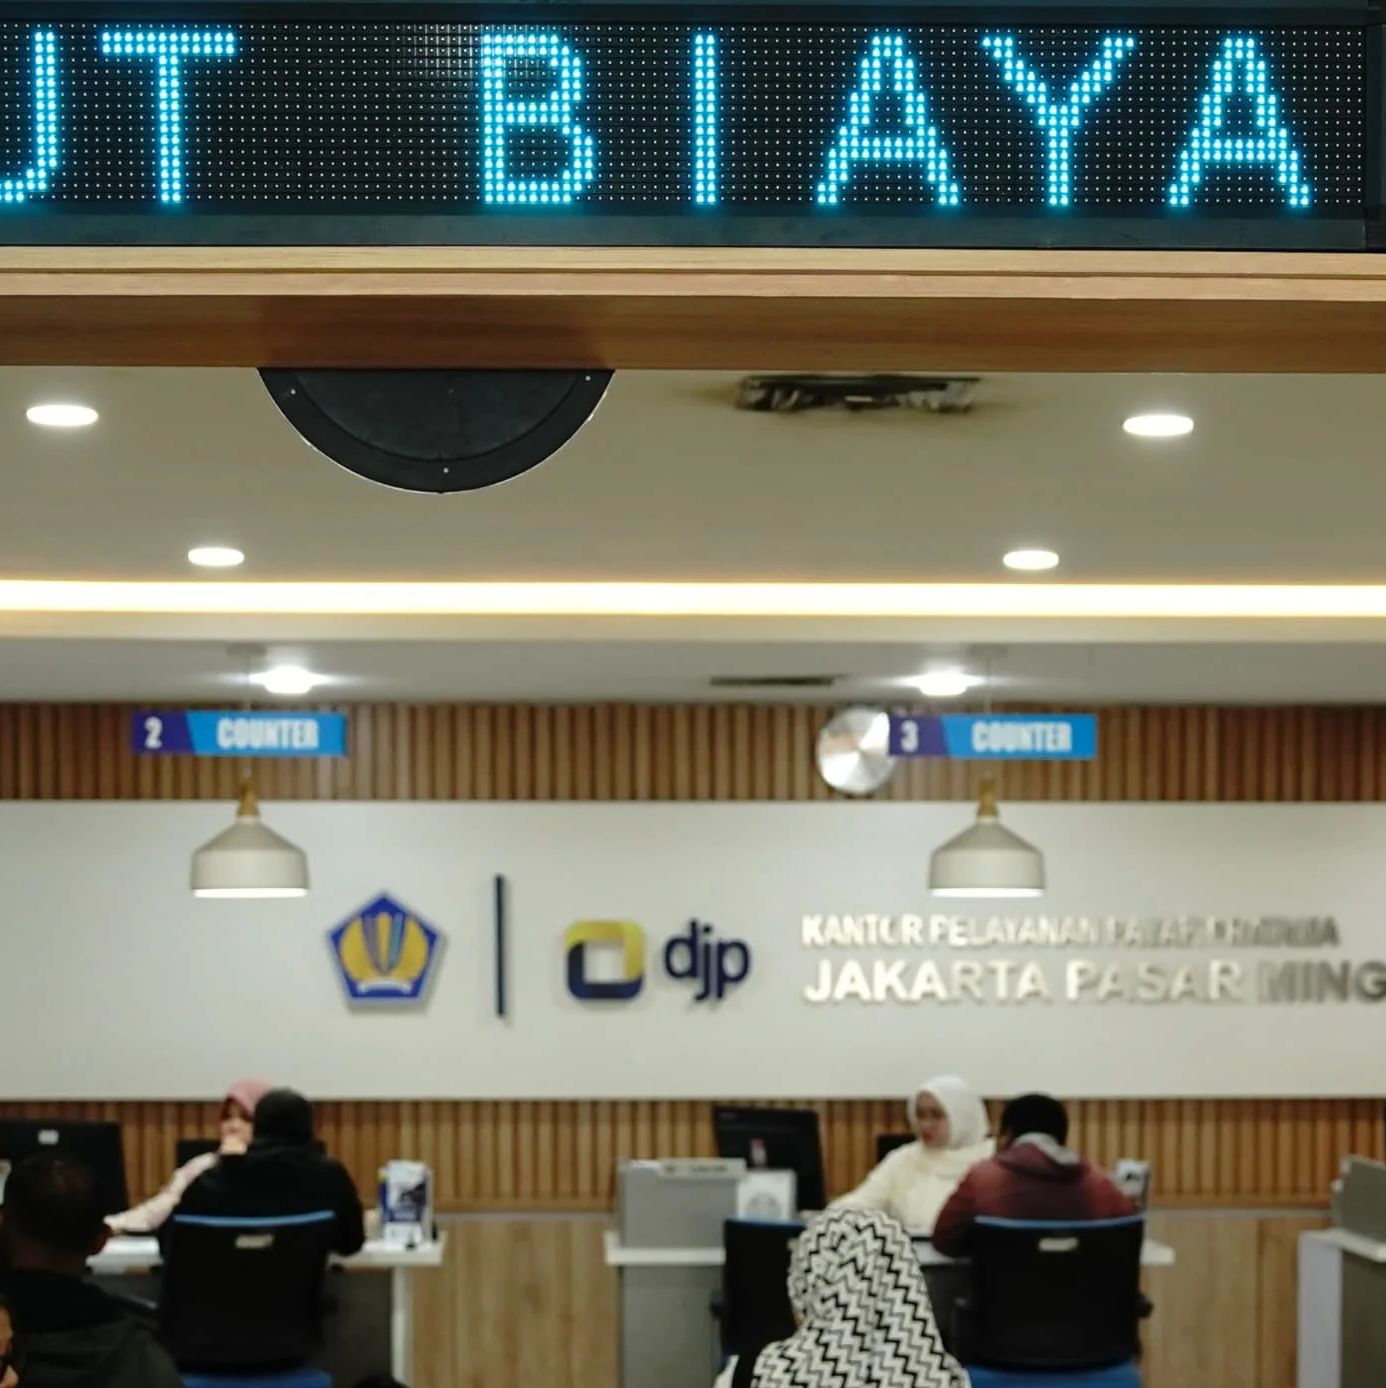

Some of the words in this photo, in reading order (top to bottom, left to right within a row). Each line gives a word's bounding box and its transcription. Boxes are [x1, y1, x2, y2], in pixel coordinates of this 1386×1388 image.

[479, 32, 1313, 210] BIAYA
[144, 716, 163, 749] 2
[216, 717, 319, 749] COUNTER
[900, 720, 919, 751] 3
[971, 720, 1073, 752] COUNTER
[801, 913, 924, 947] KANTOR
[928, 914, 1098, 948] PELAYANAN
[663, 918, 750, 1001] djp
[804, 957, 1051, 1003] JAKARTA
[1065, 958, 1244, 1003] PASAR
